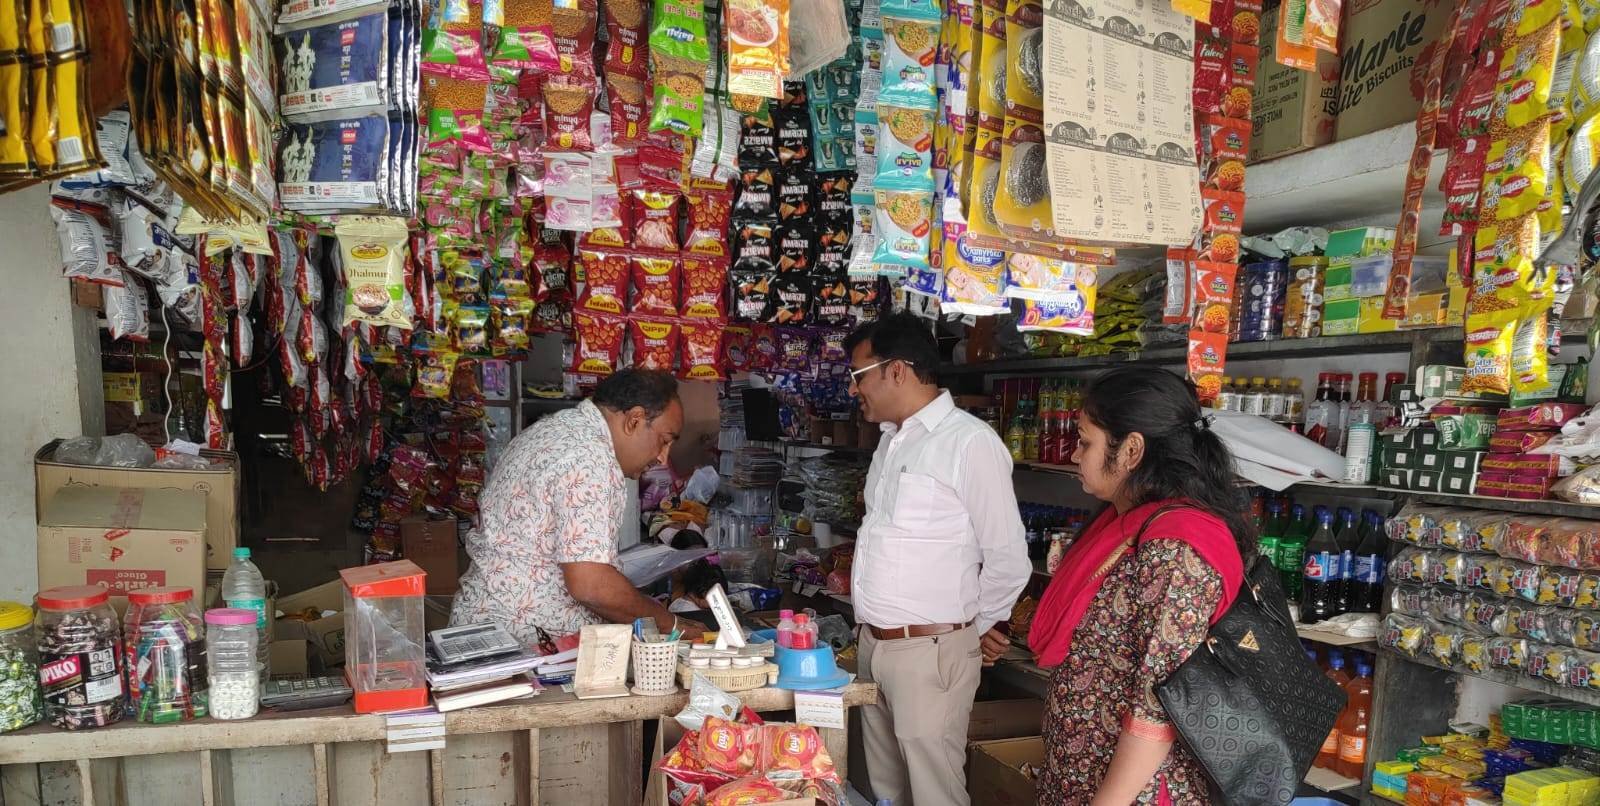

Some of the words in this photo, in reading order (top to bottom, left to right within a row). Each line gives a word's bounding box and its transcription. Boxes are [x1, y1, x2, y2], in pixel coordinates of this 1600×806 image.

[1342, 11, 1426, 84] Marie
[1366, 55, 1415, 95] Biscuits
[554, 115, 579, 124] bhujia
[558, 122, 575, 131] aloo
[1441, 419, 1455, 444] Relax
[1476, 419, 1497, 438] elax
[117, 571, 148, 580] Gluco
